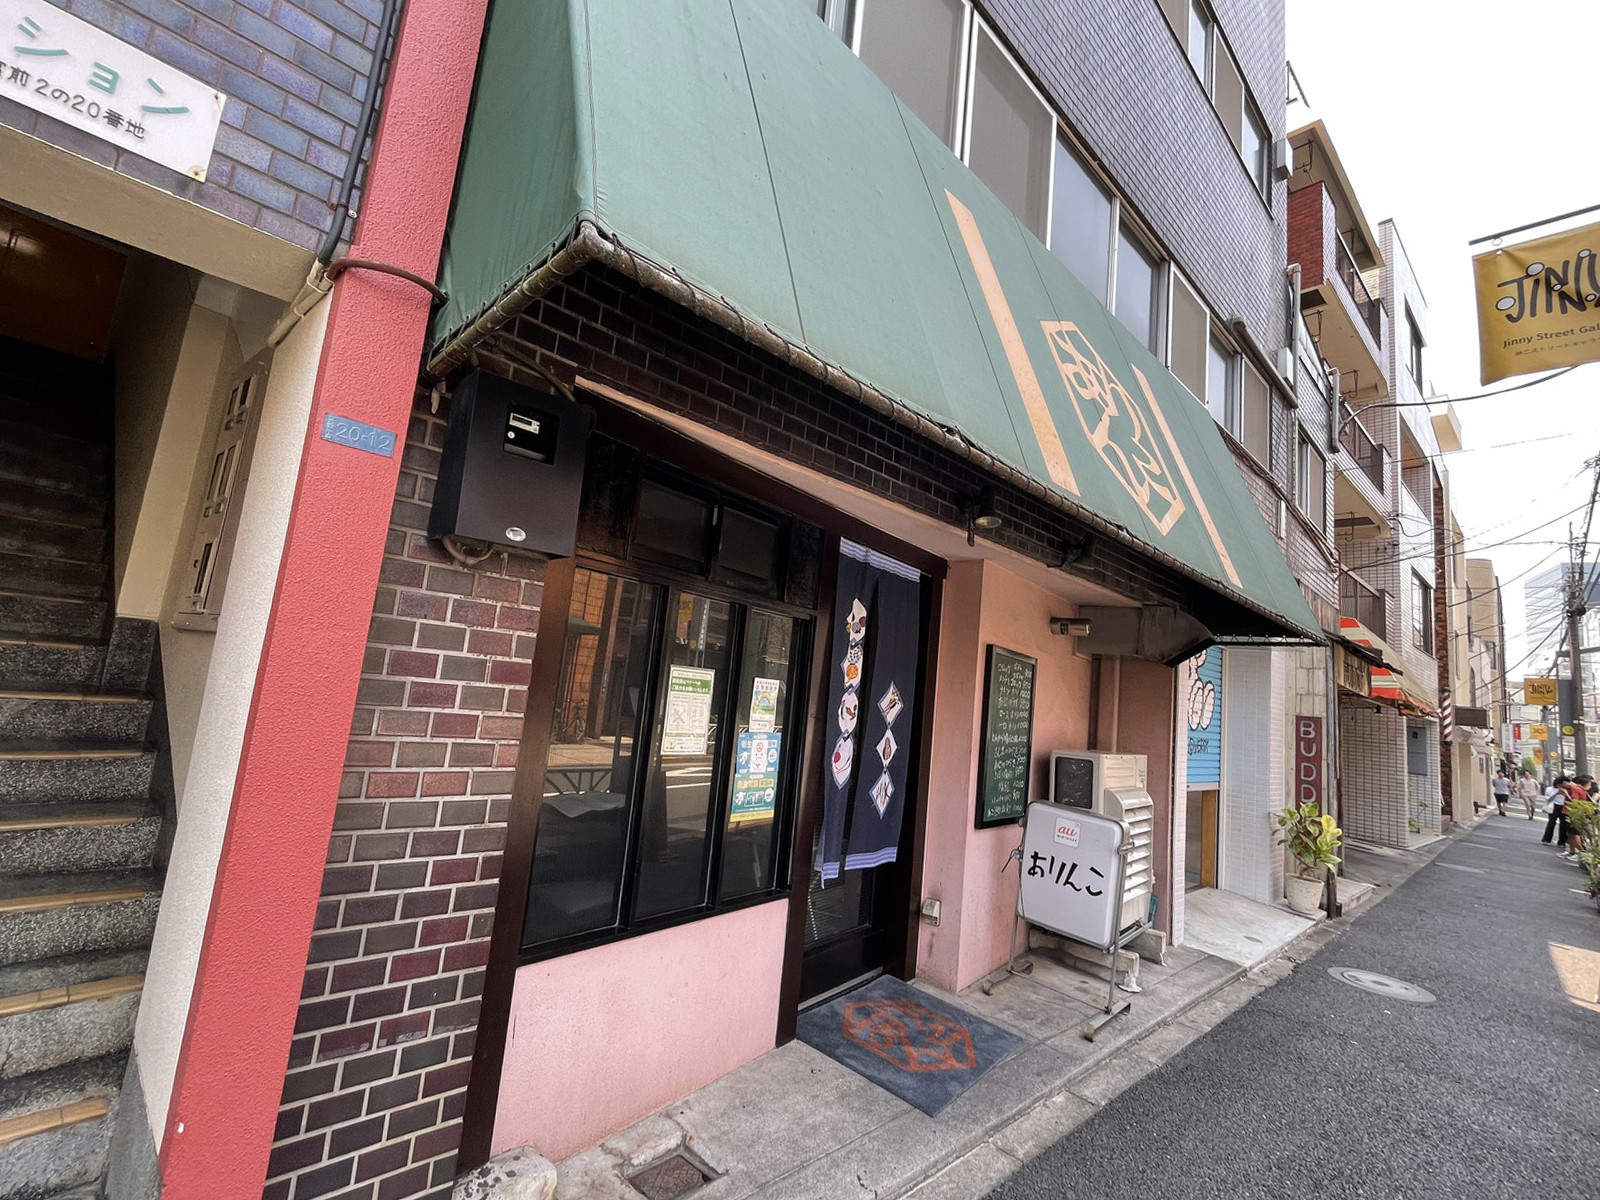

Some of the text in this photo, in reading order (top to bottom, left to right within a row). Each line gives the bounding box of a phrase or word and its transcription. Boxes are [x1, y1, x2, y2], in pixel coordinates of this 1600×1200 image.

[1503, 336, 1533, 350] Jinny
[1536, 328, 1576, 341] Street
[335, 422, 392, 451] 20-12
[1058, 826, 1078, 837] au
[1028, 851, 1105, 897] ありんこ
